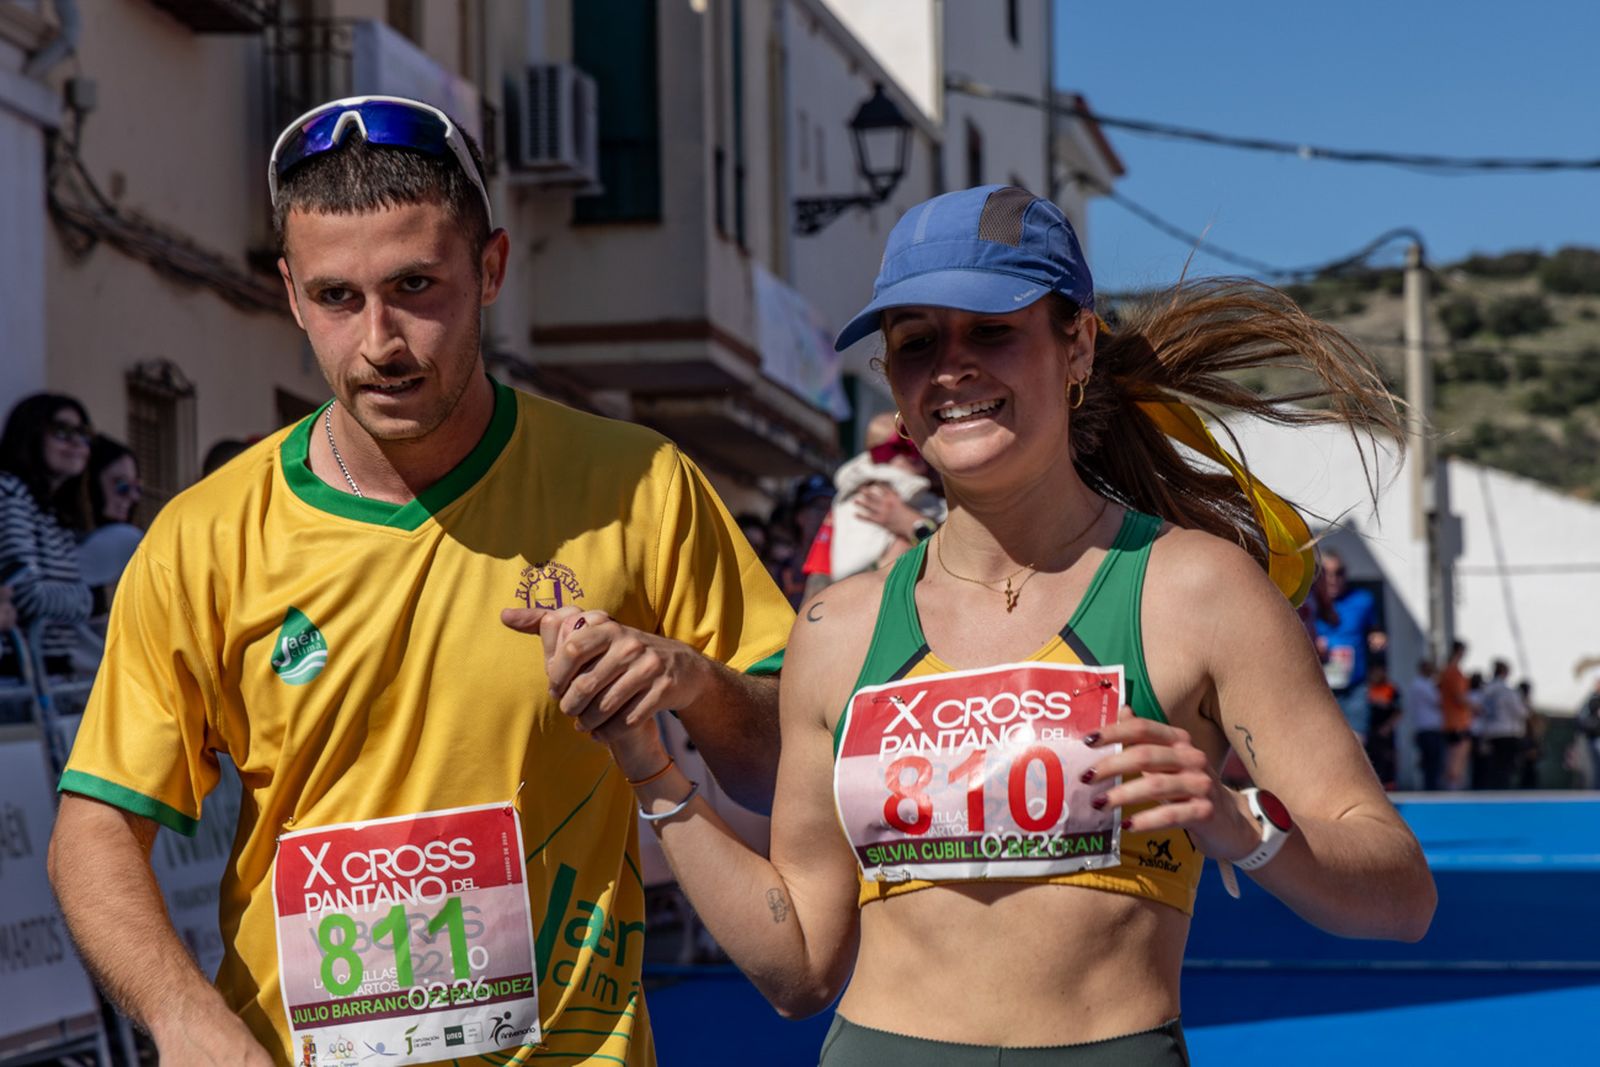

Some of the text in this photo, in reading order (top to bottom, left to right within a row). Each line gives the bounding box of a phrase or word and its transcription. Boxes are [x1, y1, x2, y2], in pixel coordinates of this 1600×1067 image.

[883, 690, 928, 733] X
[932, 690, 1072, 729] CROSS
[878, 726, 1070, 762] PANTANO DEL
[884, 746, 1065, 835] 810
[300, 838, 475, 889] X CROSS
[866, 841, 918, 864] SILVIA
[304, 876, 447, 921] PANTANO
[452, 878, 480, 892] DEL
[317, 897, 472, 996] 811
[292, 1005, 329, 1024] JULIO
[332, 993, 424, 1018] BARRANCO
[353, 980, 400, 997] ARTOS
